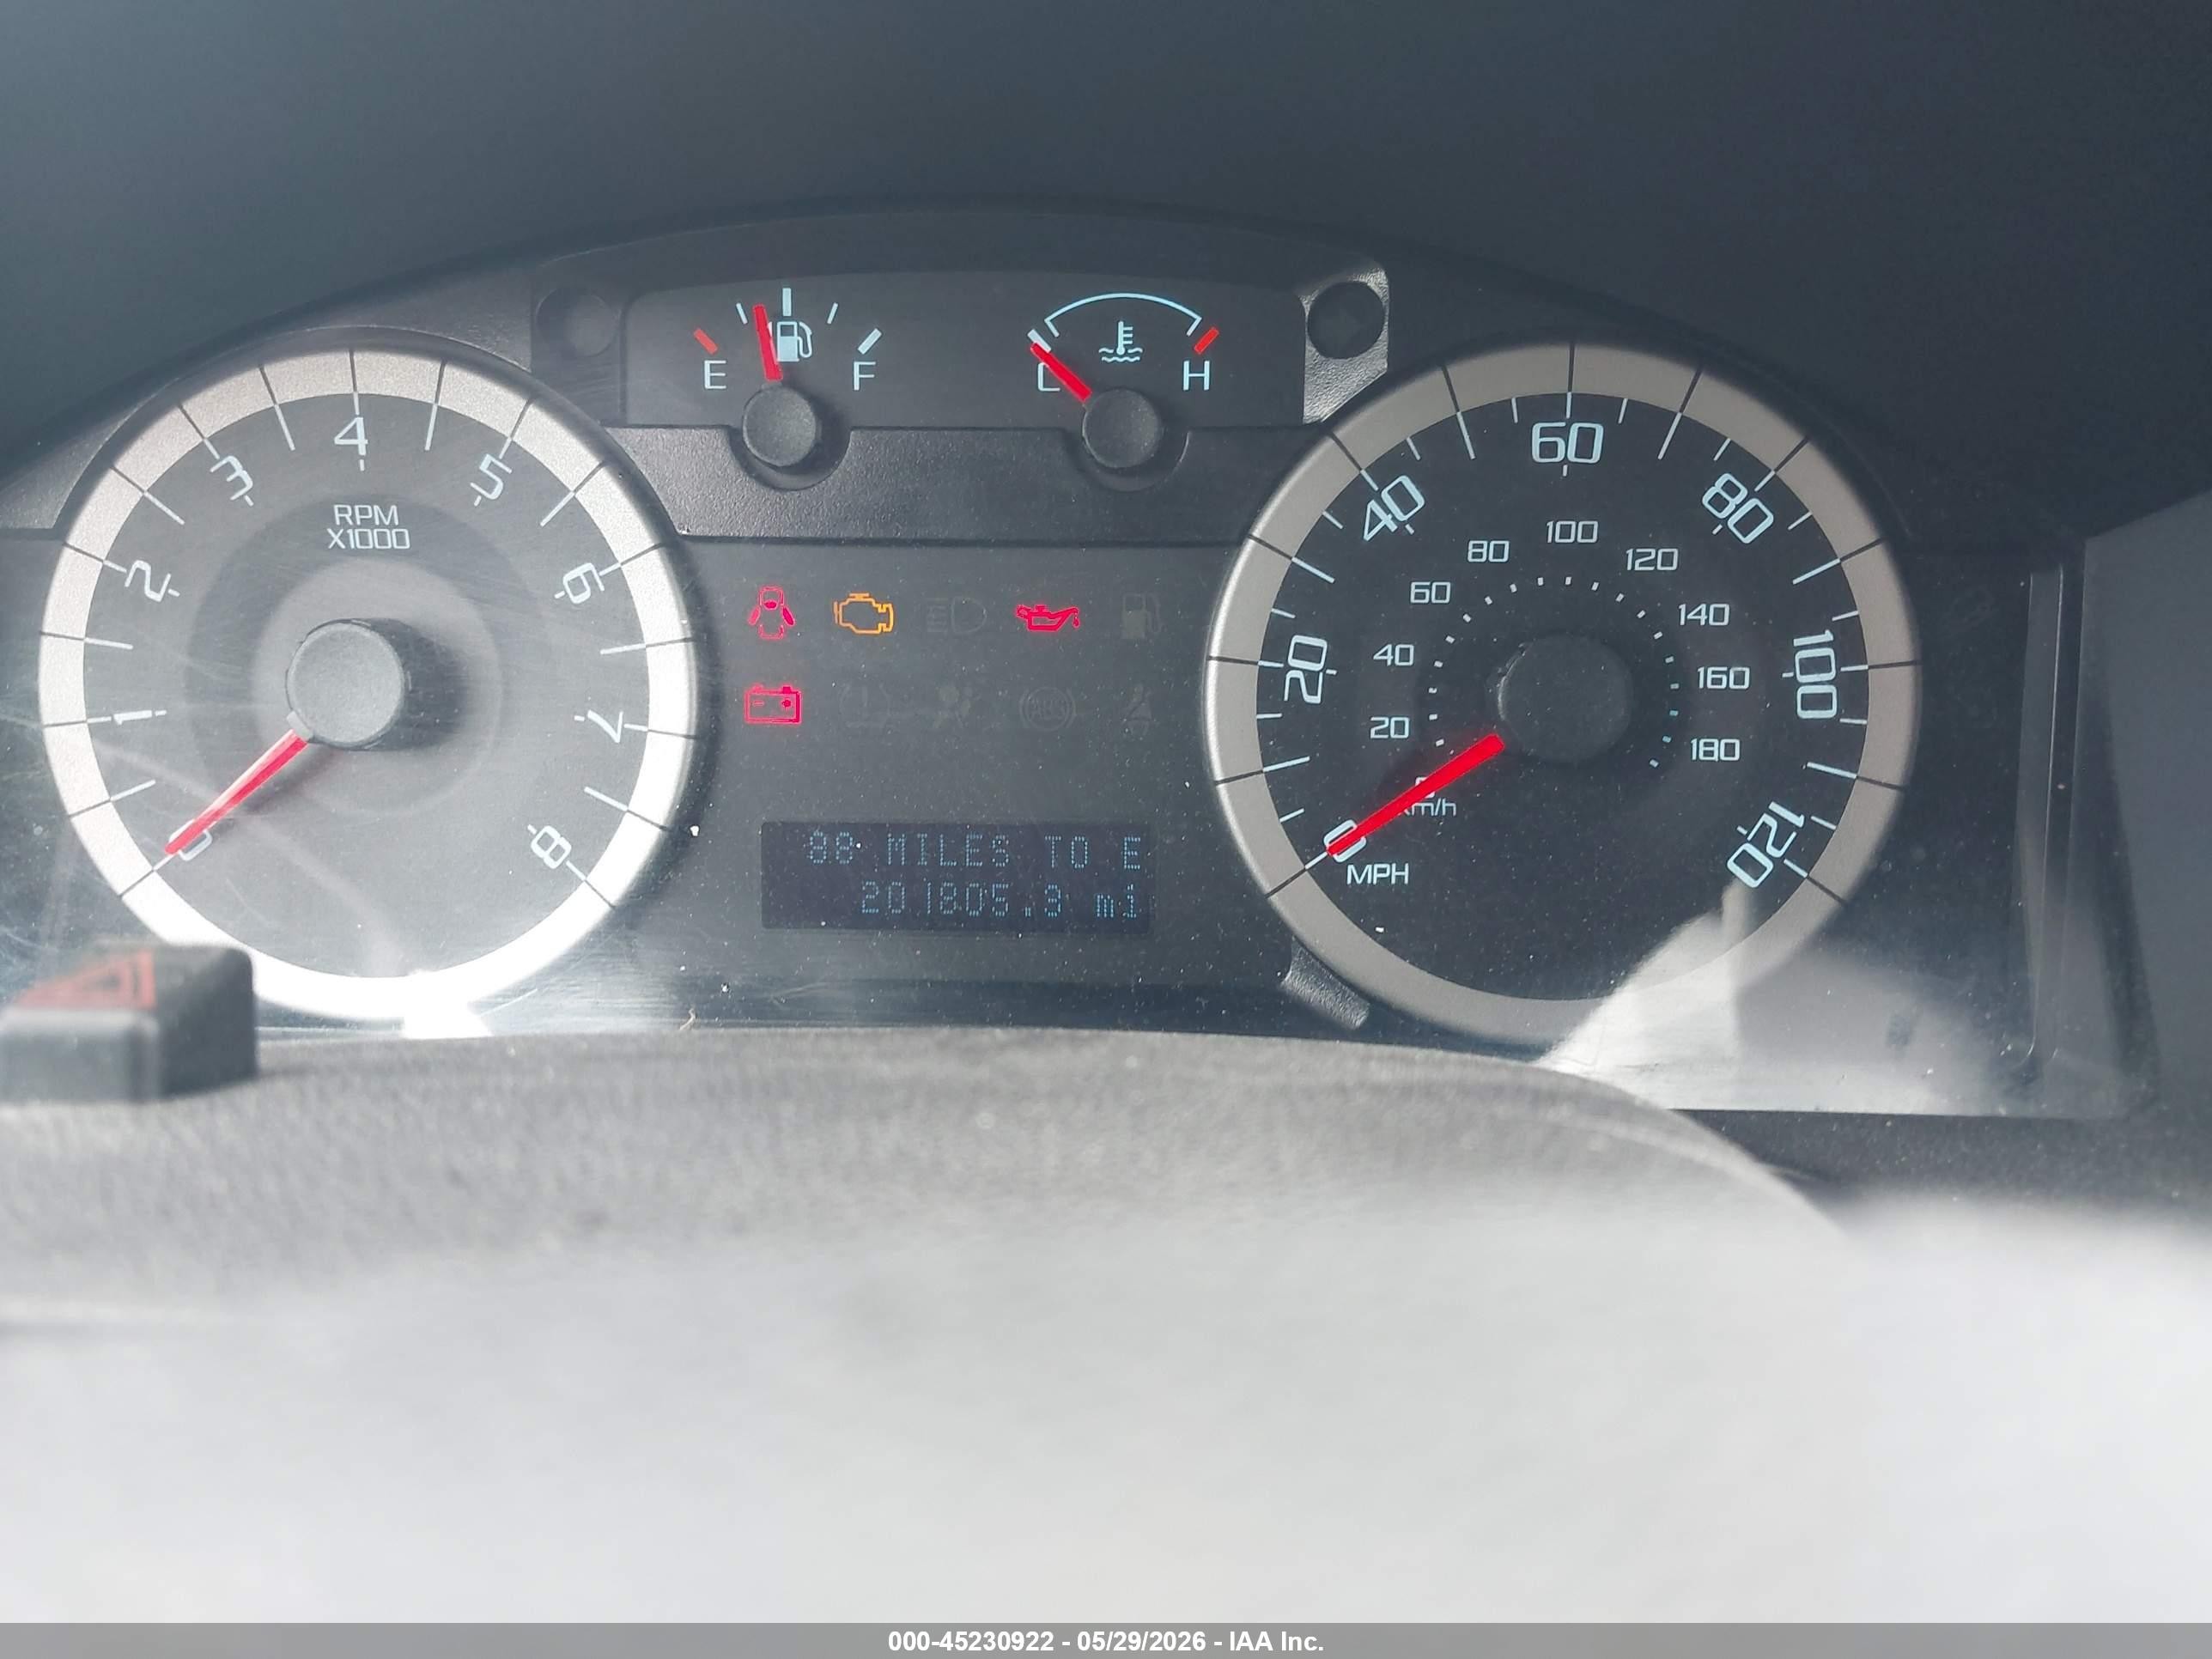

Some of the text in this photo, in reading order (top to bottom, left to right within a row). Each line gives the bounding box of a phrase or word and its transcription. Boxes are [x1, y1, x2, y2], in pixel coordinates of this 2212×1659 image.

[704, 361, 726, 391] E
[854, 362, 876, 391] F
[1183, 361, 1211, 391] H
[333, 416, 369, 455] 4
[1530, 421, 1604, 465] 60
[210, 455, 254, 501] 3
[471, 452, 513, 501] 5
[334, 505, 399, 526] RPM
[1363, 474, 1426, 542] 40
[1702, 472, 1774, 544] 80
[327, 528, 411, 550] X1000
[1547, 520, 1599, 544] 100
[1467, 540, 1510, 563] 80
[1626, 548, 1679, 571] 120
[125, 560, 173, 602] 2
[562, 562, 605, 605] 6
[1410, 580, 1451, 605] 60
[1678, 603, 1730, 626] 140
[1284, 635, 1329, 706] 20
[1373, 644, 1415, 667] 40
[1697, 665, 1750, 690] 160
[1793, 629, 1838, 721] 100
[112, 708, 155, 726] 1
[587, 709, 624, 744] 7
[1370, 716, 1410, 740] 20
[1691, 738, 1741, 762] 180
[530, 824, 573, 870] 8
[809, 830, 1142, 871] 88 MILES TO E
[1726, 801, 1805, 889] 120
[1346, 862, 1410, 885] MPH
[861, 881, 1137, 919] 201805.3 mi
